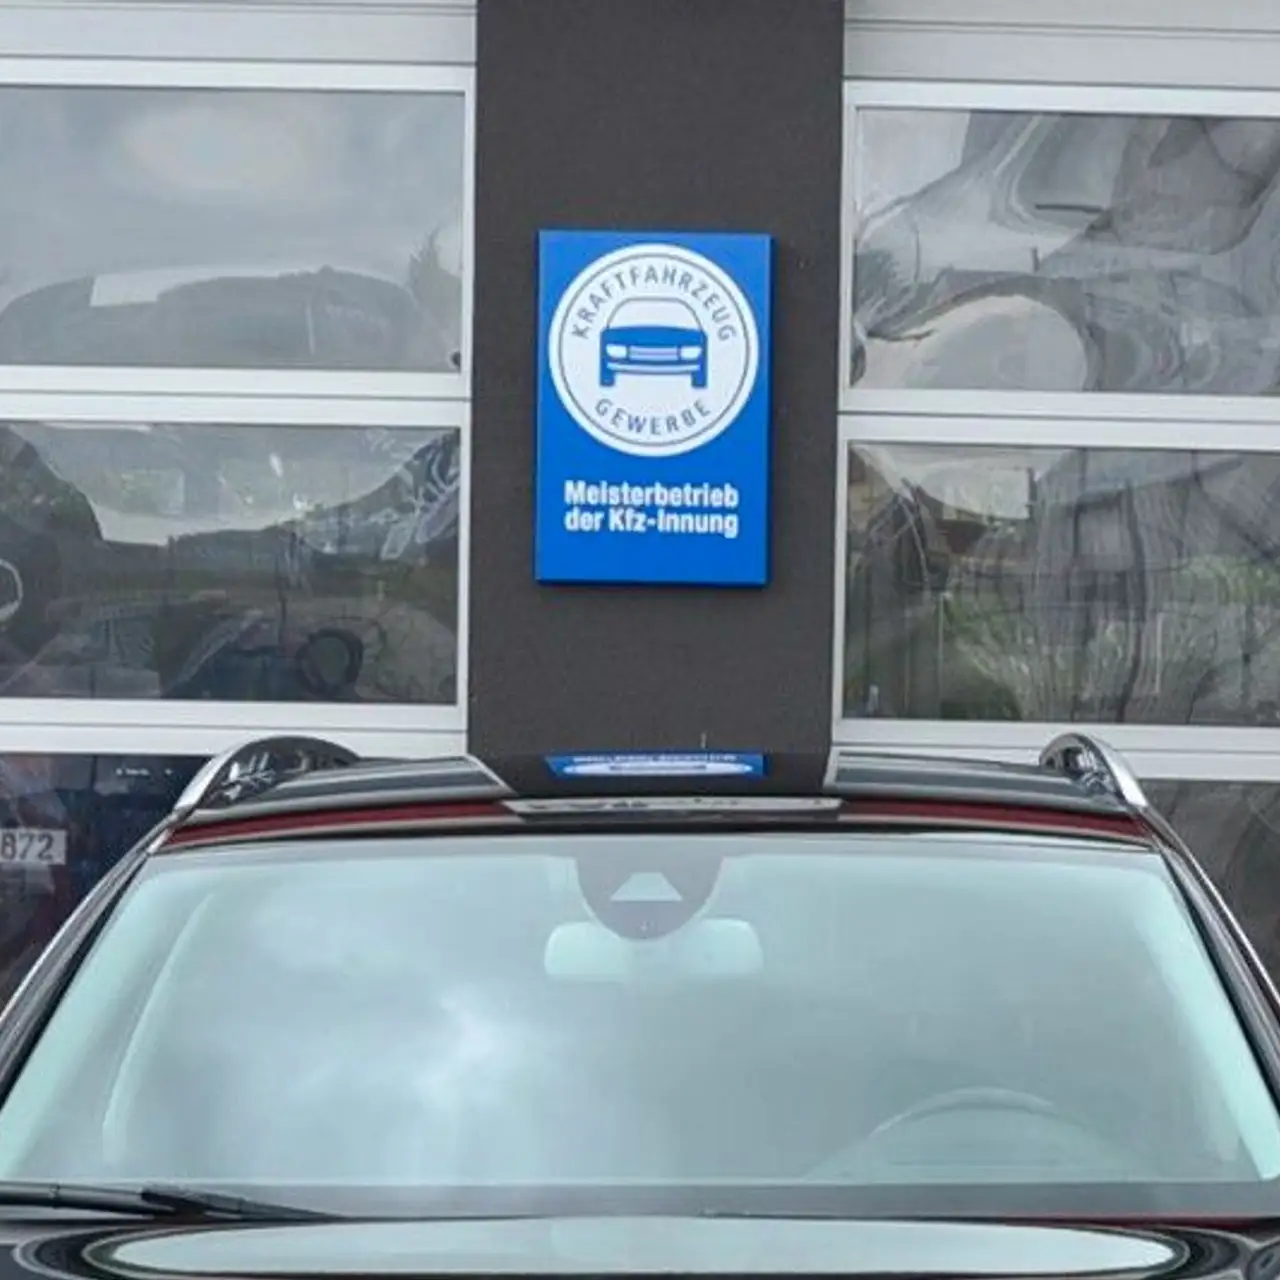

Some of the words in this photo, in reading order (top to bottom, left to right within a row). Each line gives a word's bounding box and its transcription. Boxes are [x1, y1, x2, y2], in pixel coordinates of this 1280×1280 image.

[570, 264, 738, 343] KRAFTFAHRZEUG
[595, 397, 712, 436] GEWERBE
[564, 480, 740, 508] Meisterbetrieb
[564, 507, 605, 532] der
[608, 507, 739, 539] Kfz-Innung
